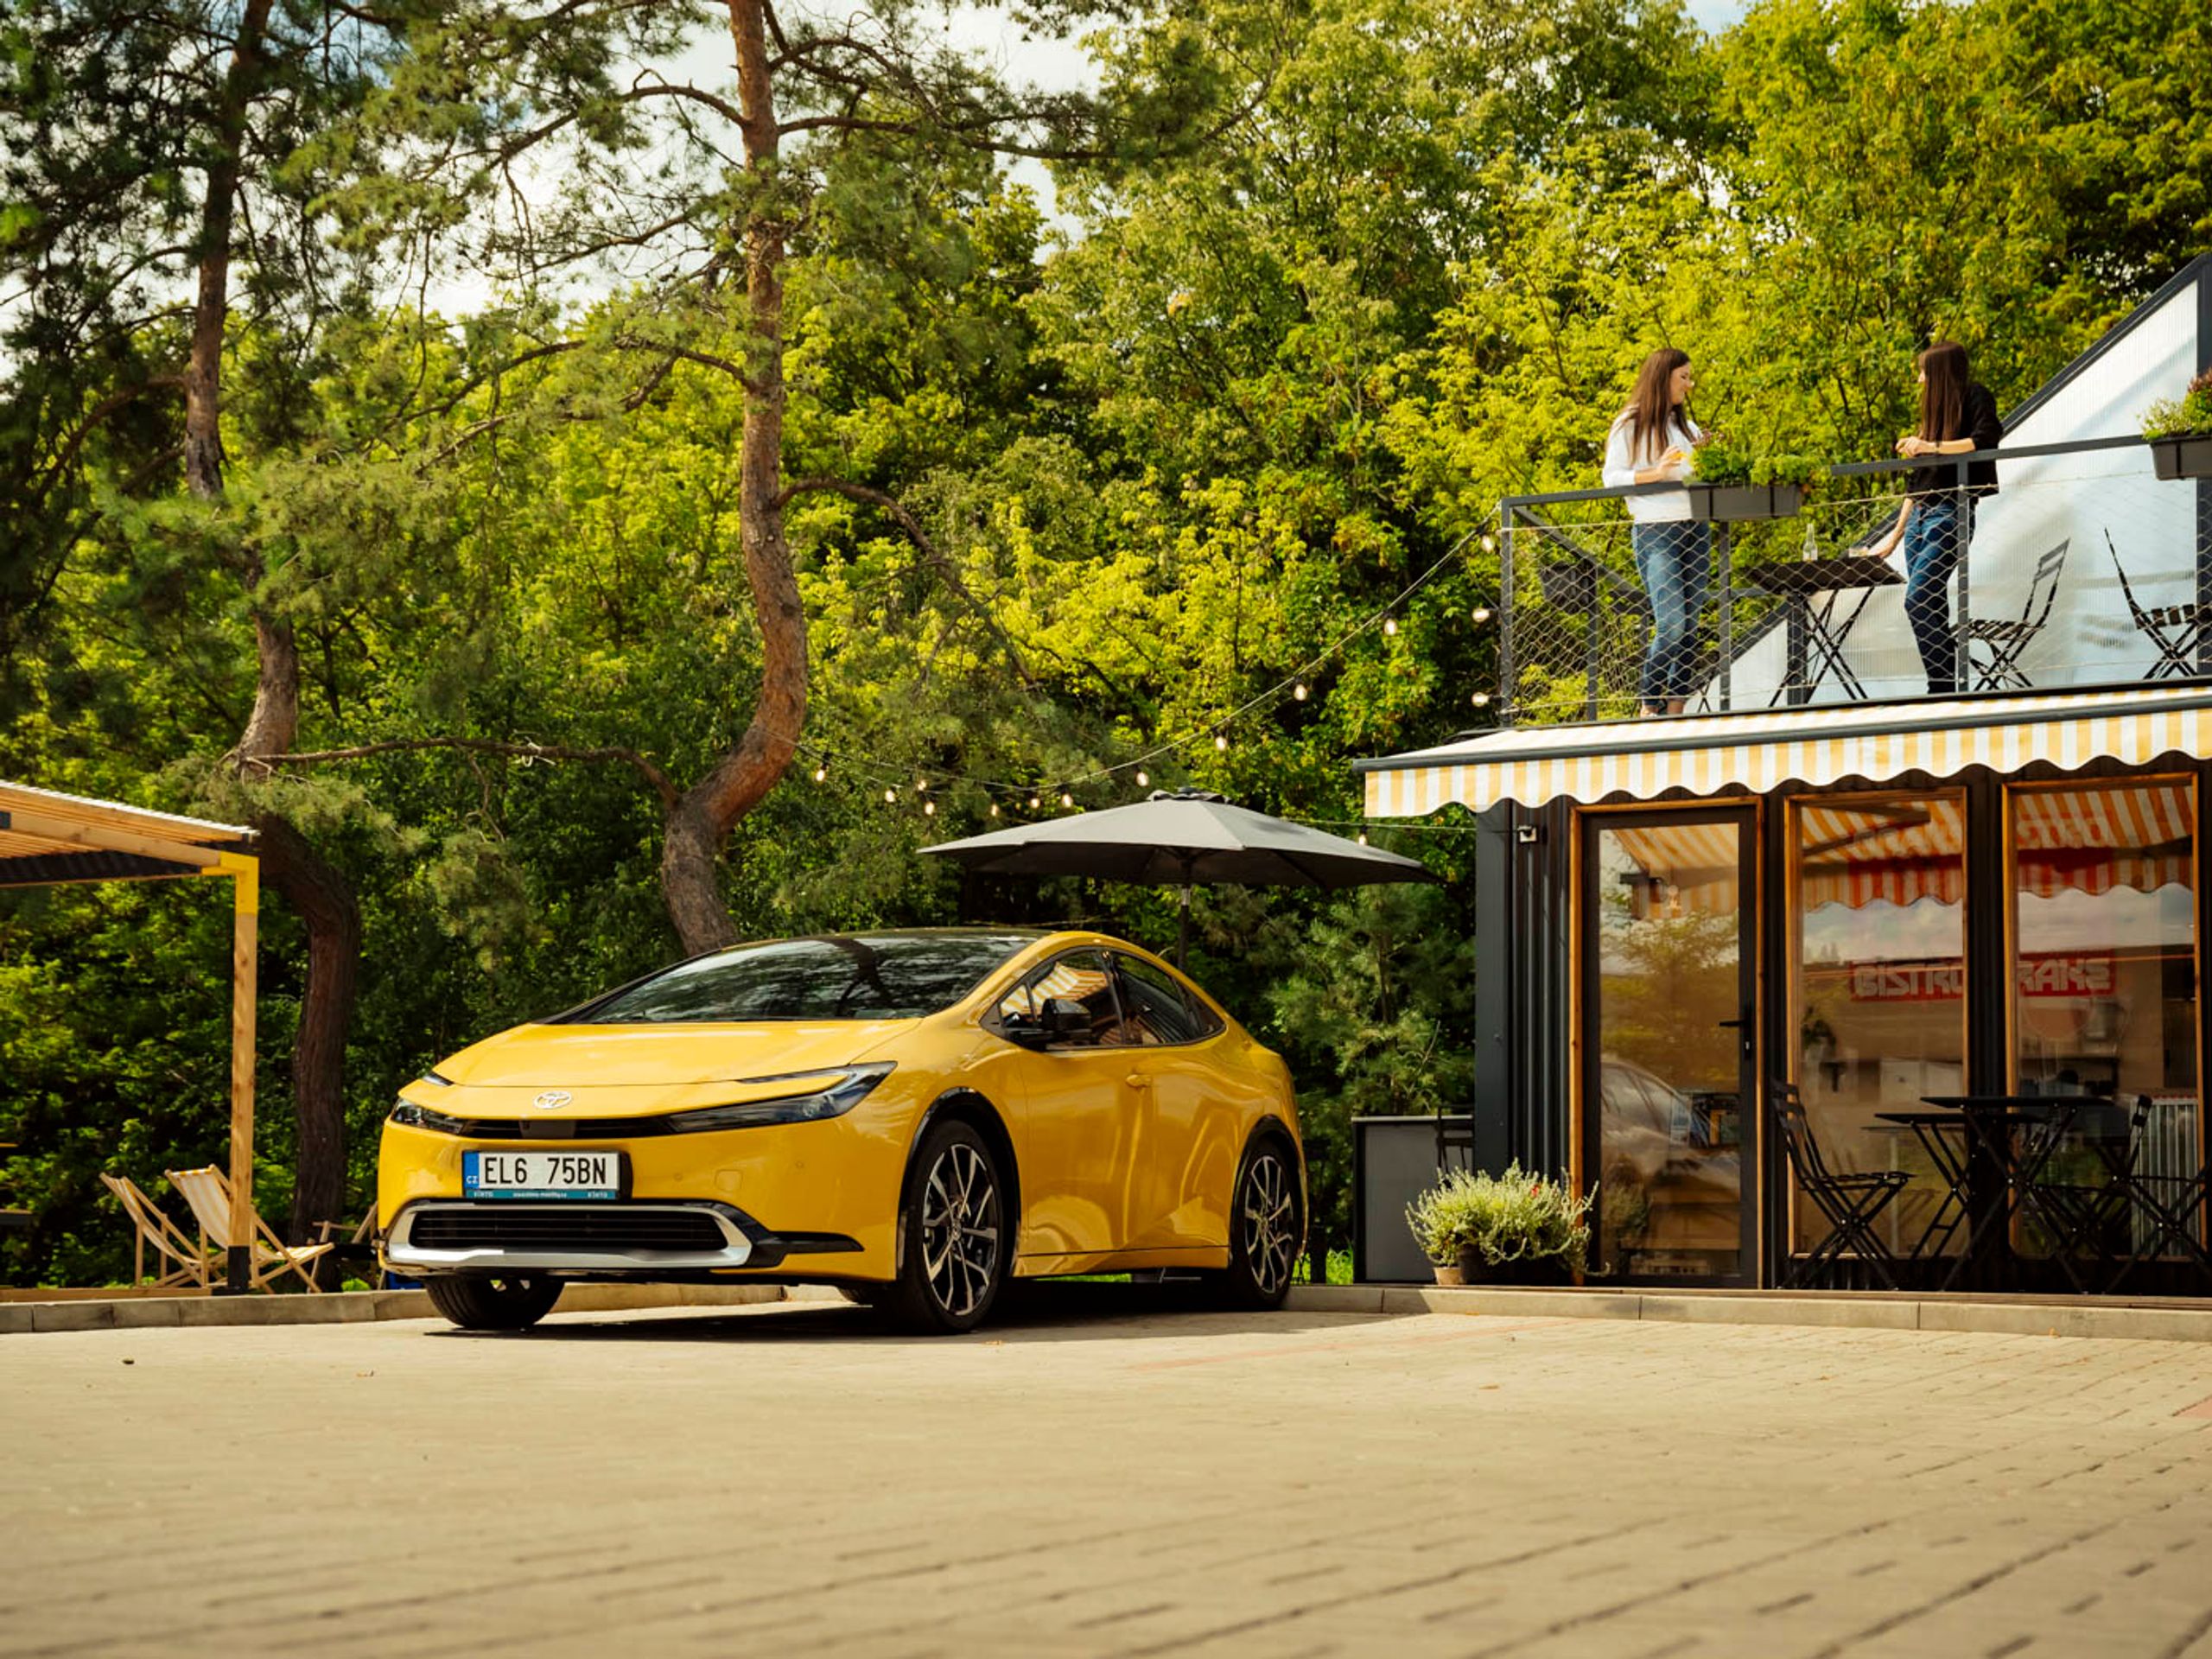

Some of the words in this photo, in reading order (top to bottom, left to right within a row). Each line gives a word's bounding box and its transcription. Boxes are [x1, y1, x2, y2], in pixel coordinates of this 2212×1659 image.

[466, 1175, 479, 1184] CZ
[485, 1157, 528, 1184] EL6
[547, 1157, 607, 1185] 75BN
